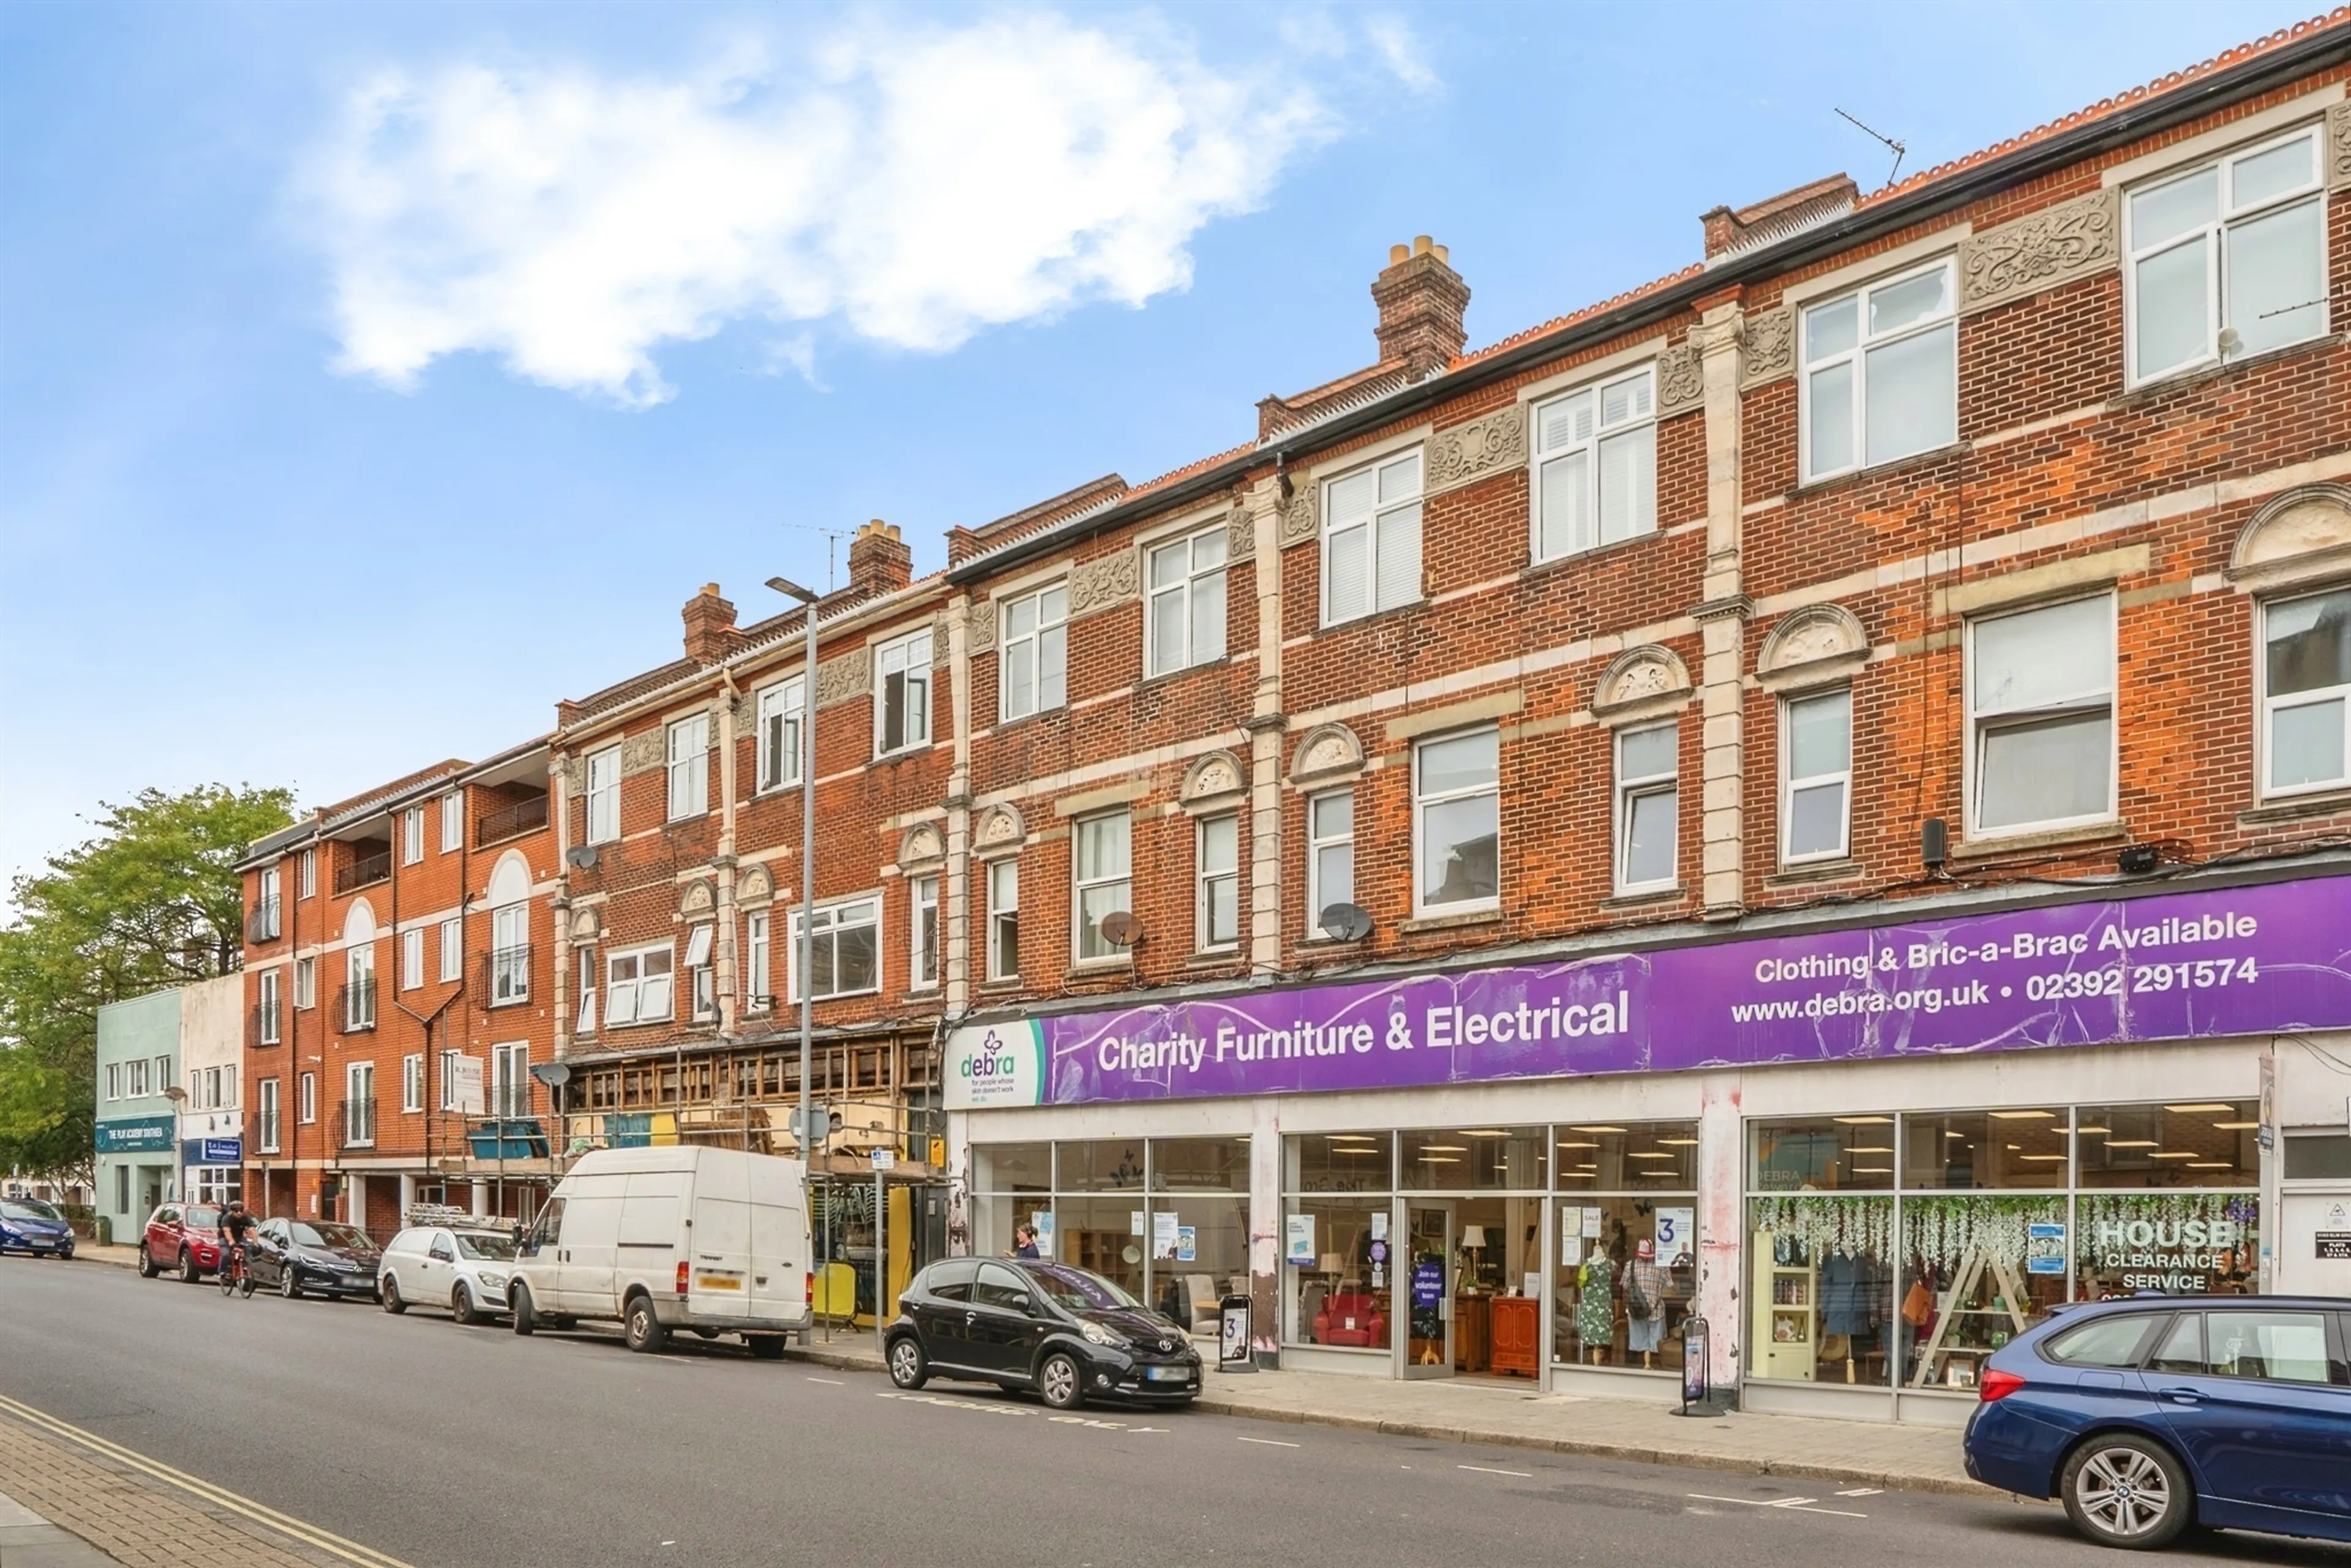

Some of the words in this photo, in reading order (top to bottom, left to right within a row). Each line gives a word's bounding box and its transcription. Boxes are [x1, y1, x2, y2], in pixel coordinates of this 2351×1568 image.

[1755, 953, 1869, 982] Clothing
[1878, 947, 1899, 971] &
[1908, 932, 2088, 969] Bric-a-Brac
[2098, 912, 2257, 951] Available
[1731, 980, 1989, 1022] www.debra.org.uk
[2026, 969, 2123, 1001] 02392
[2133, 956, 2259, 993] 291574
[1098, 1032, 1206, 1073] Charity
[1217, 1021, 1374, 1062] Furniture
[1385, 1011, 1414, 1051] &
[1427, 990, 1629, 1048] Electrical
[961, 1052, 1014, 1077] debra
[980, 1078, 997, 1086] people
[108, 1130, 117, 1139] THE
[1657, 1218, 1674, 1243] 3
[2099, 1220, 2232, 1247] HOUSE
[2105, 1253, 2224, 1269] CLEARANCE
[1415, 1281, 1442, 1289] volunteer
[2123, 1274, 2205, 1289] SERVICE
[1225, 1318, 1235, 1338] 3
